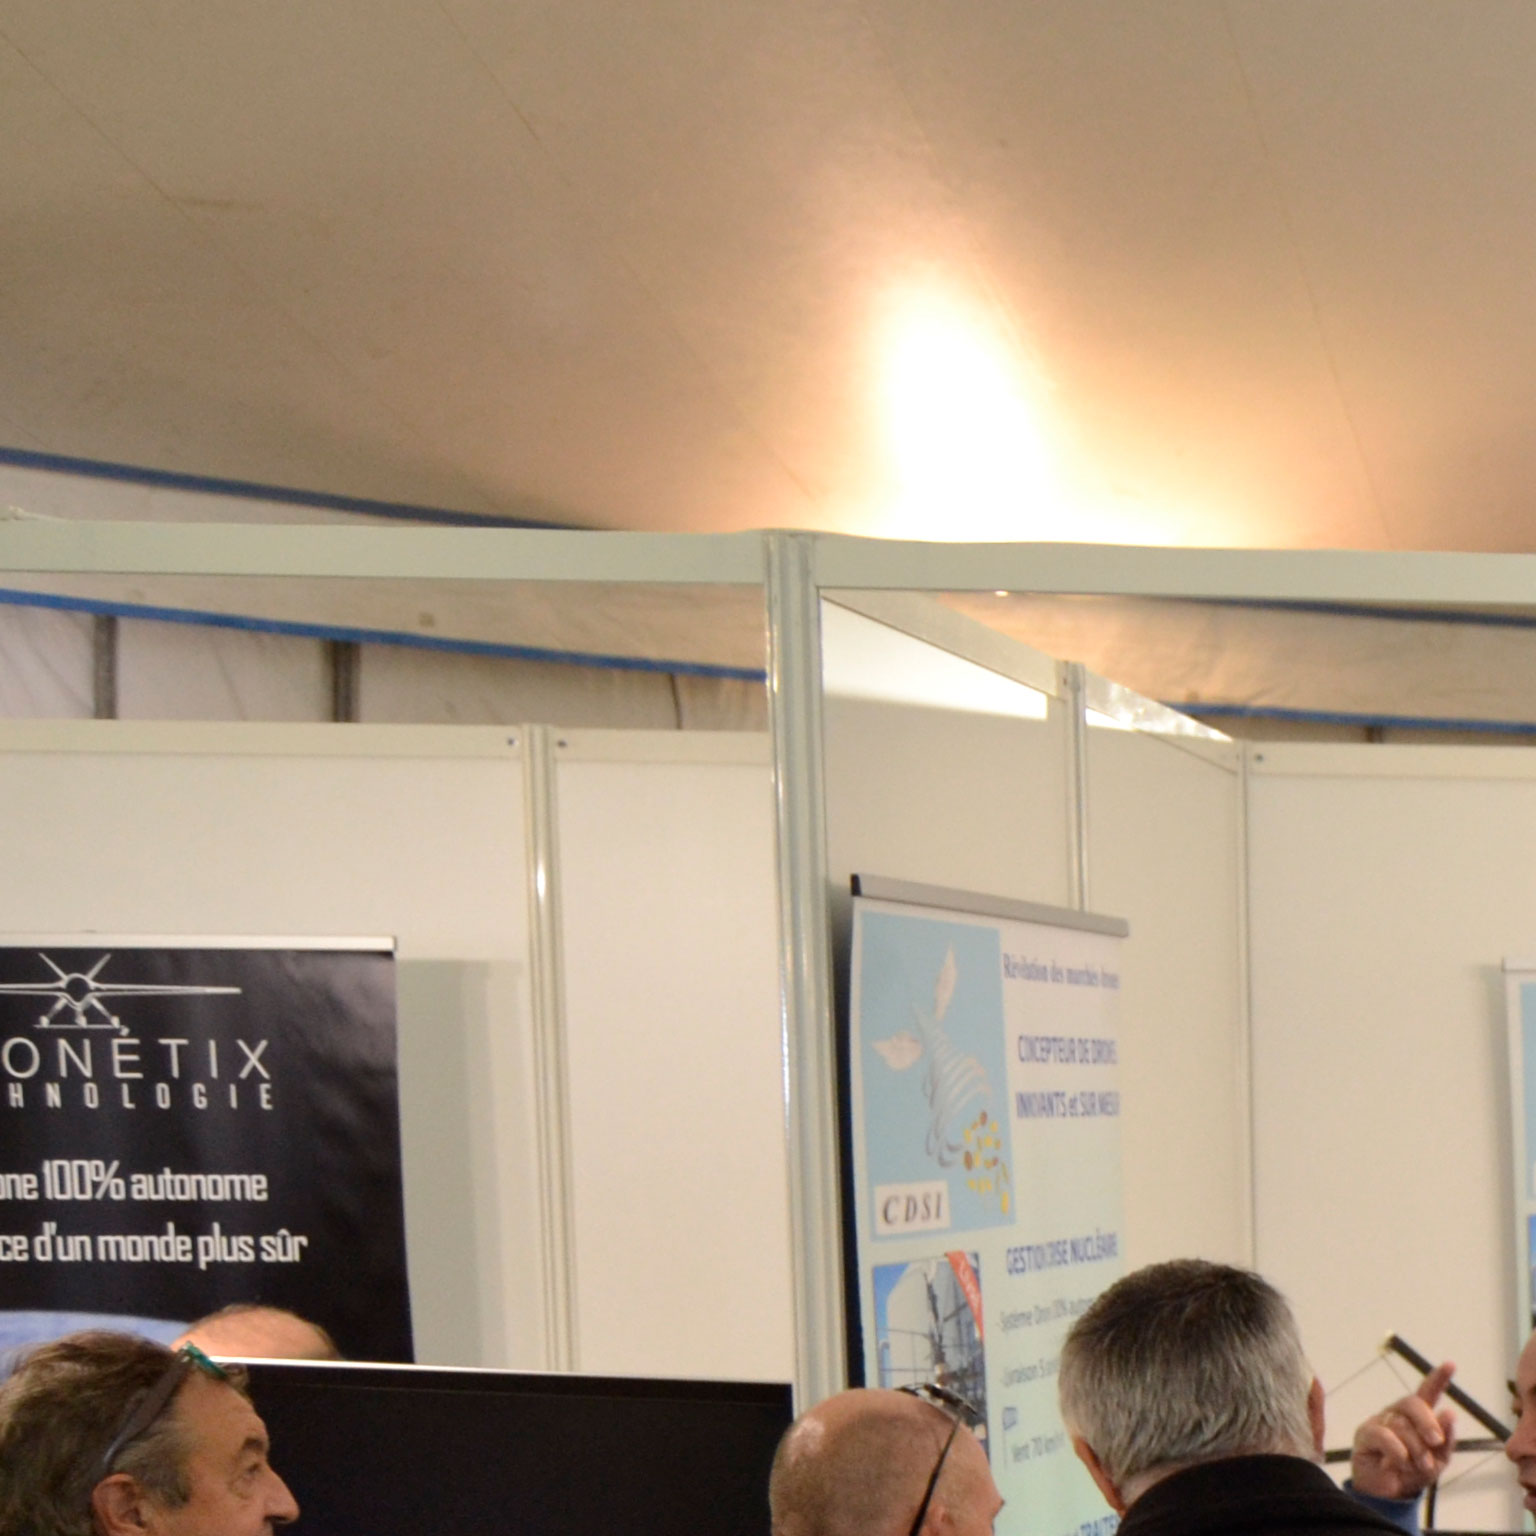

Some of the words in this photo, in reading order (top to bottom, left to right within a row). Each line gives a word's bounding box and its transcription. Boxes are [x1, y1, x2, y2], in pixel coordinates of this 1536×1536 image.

[42, 1160, 126, 1200] 100%
[131, 1167, 268, 1200] autonome
[882, 1191, 944, 1226] CDSI
[34, 1221, 92, 1262] d'un
[98, 1221, 193, 1262] monde
[197, 1221, 255, 1270] plus
[260, 1228, 308, 1262] sûr
